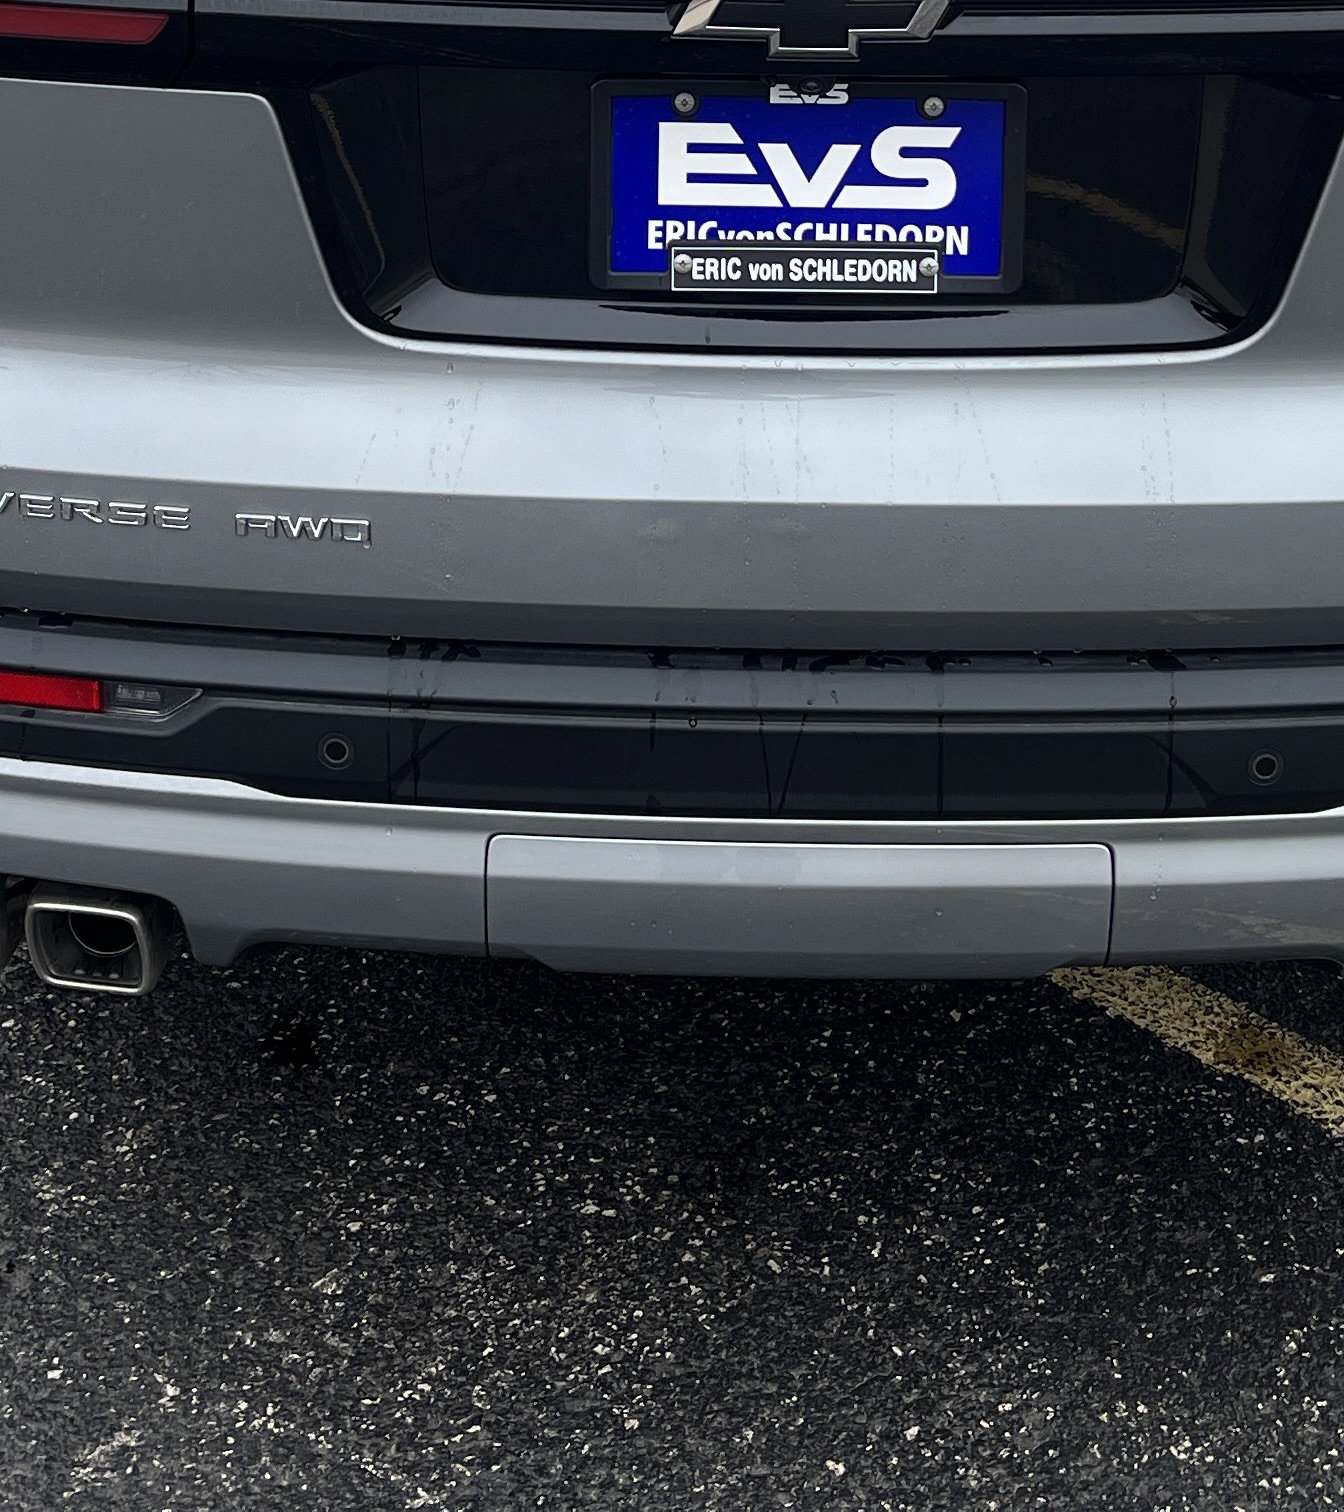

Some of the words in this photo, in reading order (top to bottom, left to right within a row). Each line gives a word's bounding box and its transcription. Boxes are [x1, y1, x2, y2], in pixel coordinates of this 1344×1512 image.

[691, 257, 742, 281] ERIC
[748, 260, 784, 282] von
[788, 257, 918, 283] SCHLEDORN
[234, 511, 372, 543] AWD
